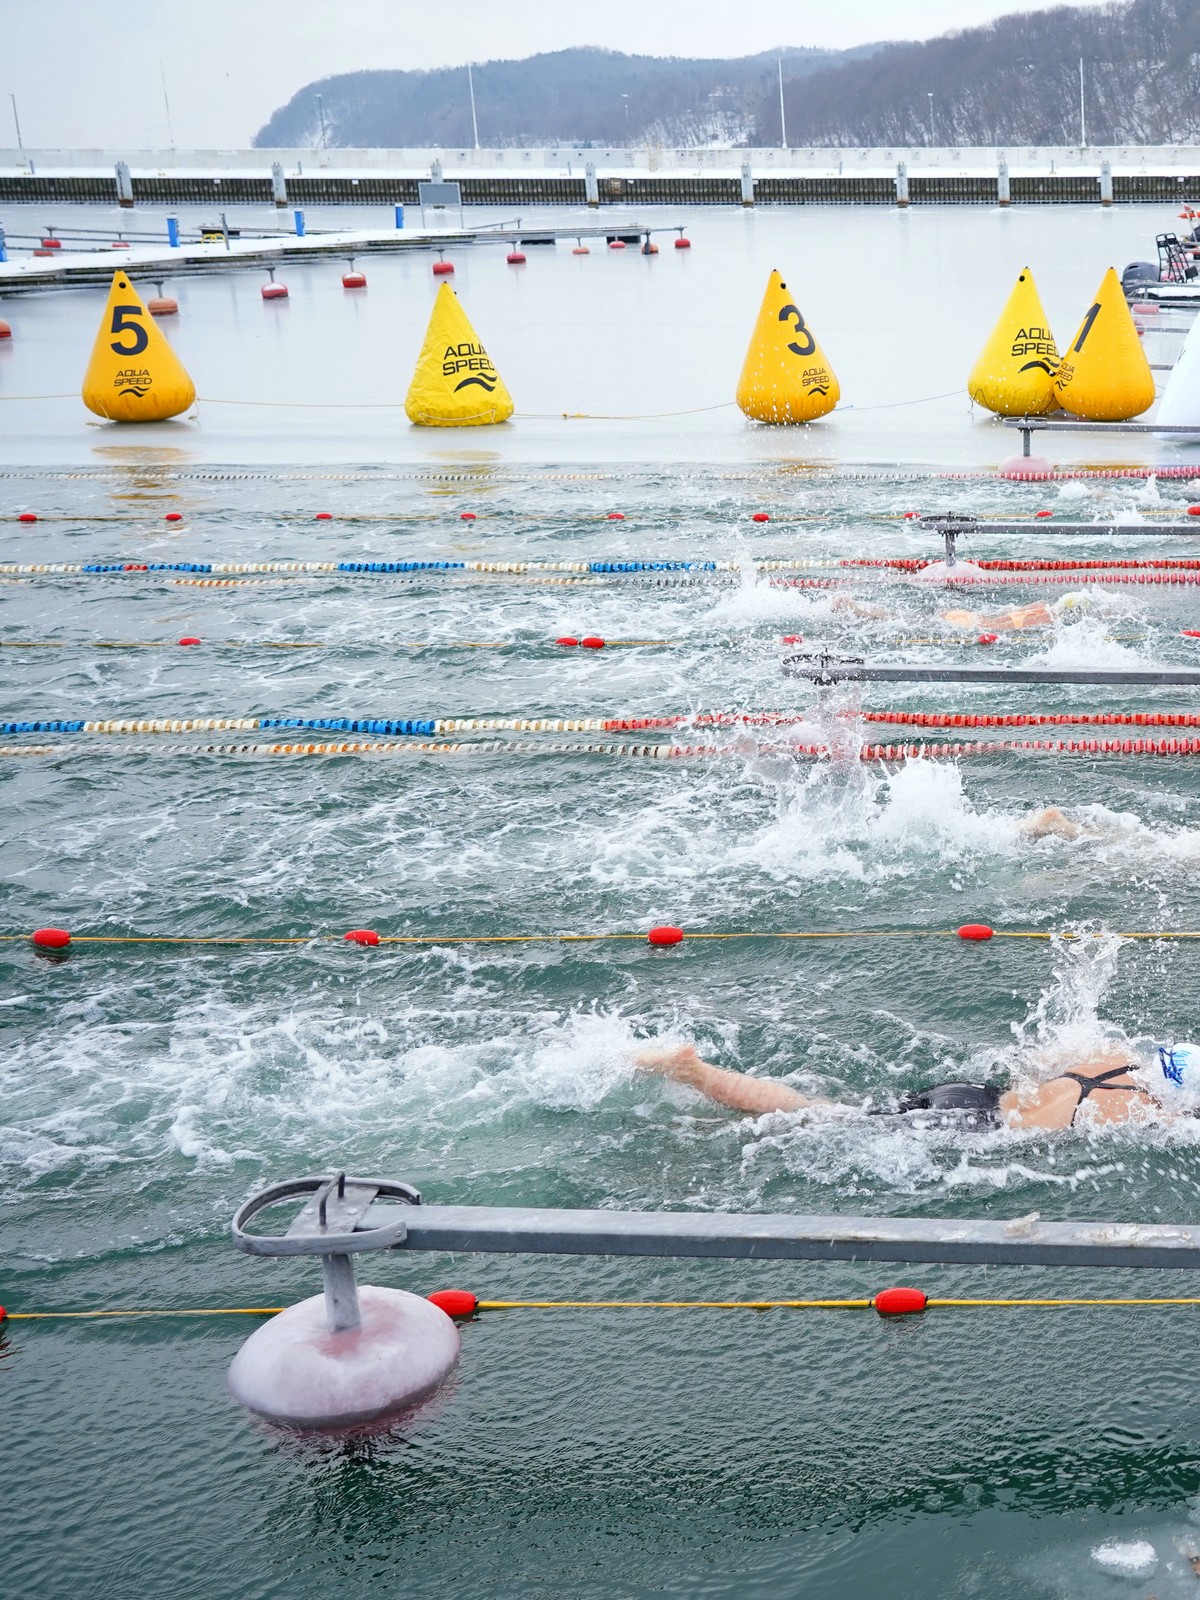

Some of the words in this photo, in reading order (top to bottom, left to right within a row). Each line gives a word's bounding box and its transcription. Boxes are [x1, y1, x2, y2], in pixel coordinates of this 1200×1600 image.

[110, 305, 149, 356] 5
[778, 304, 816, 356] 3
[1073, 302, 1102, 353] 1
[115, 369, 150, 378] AQUA
[802, 367, 827, 378] AQUA
[113, 377, 153, 387] SPEED
[801, 375, 830, 387] SPEED
